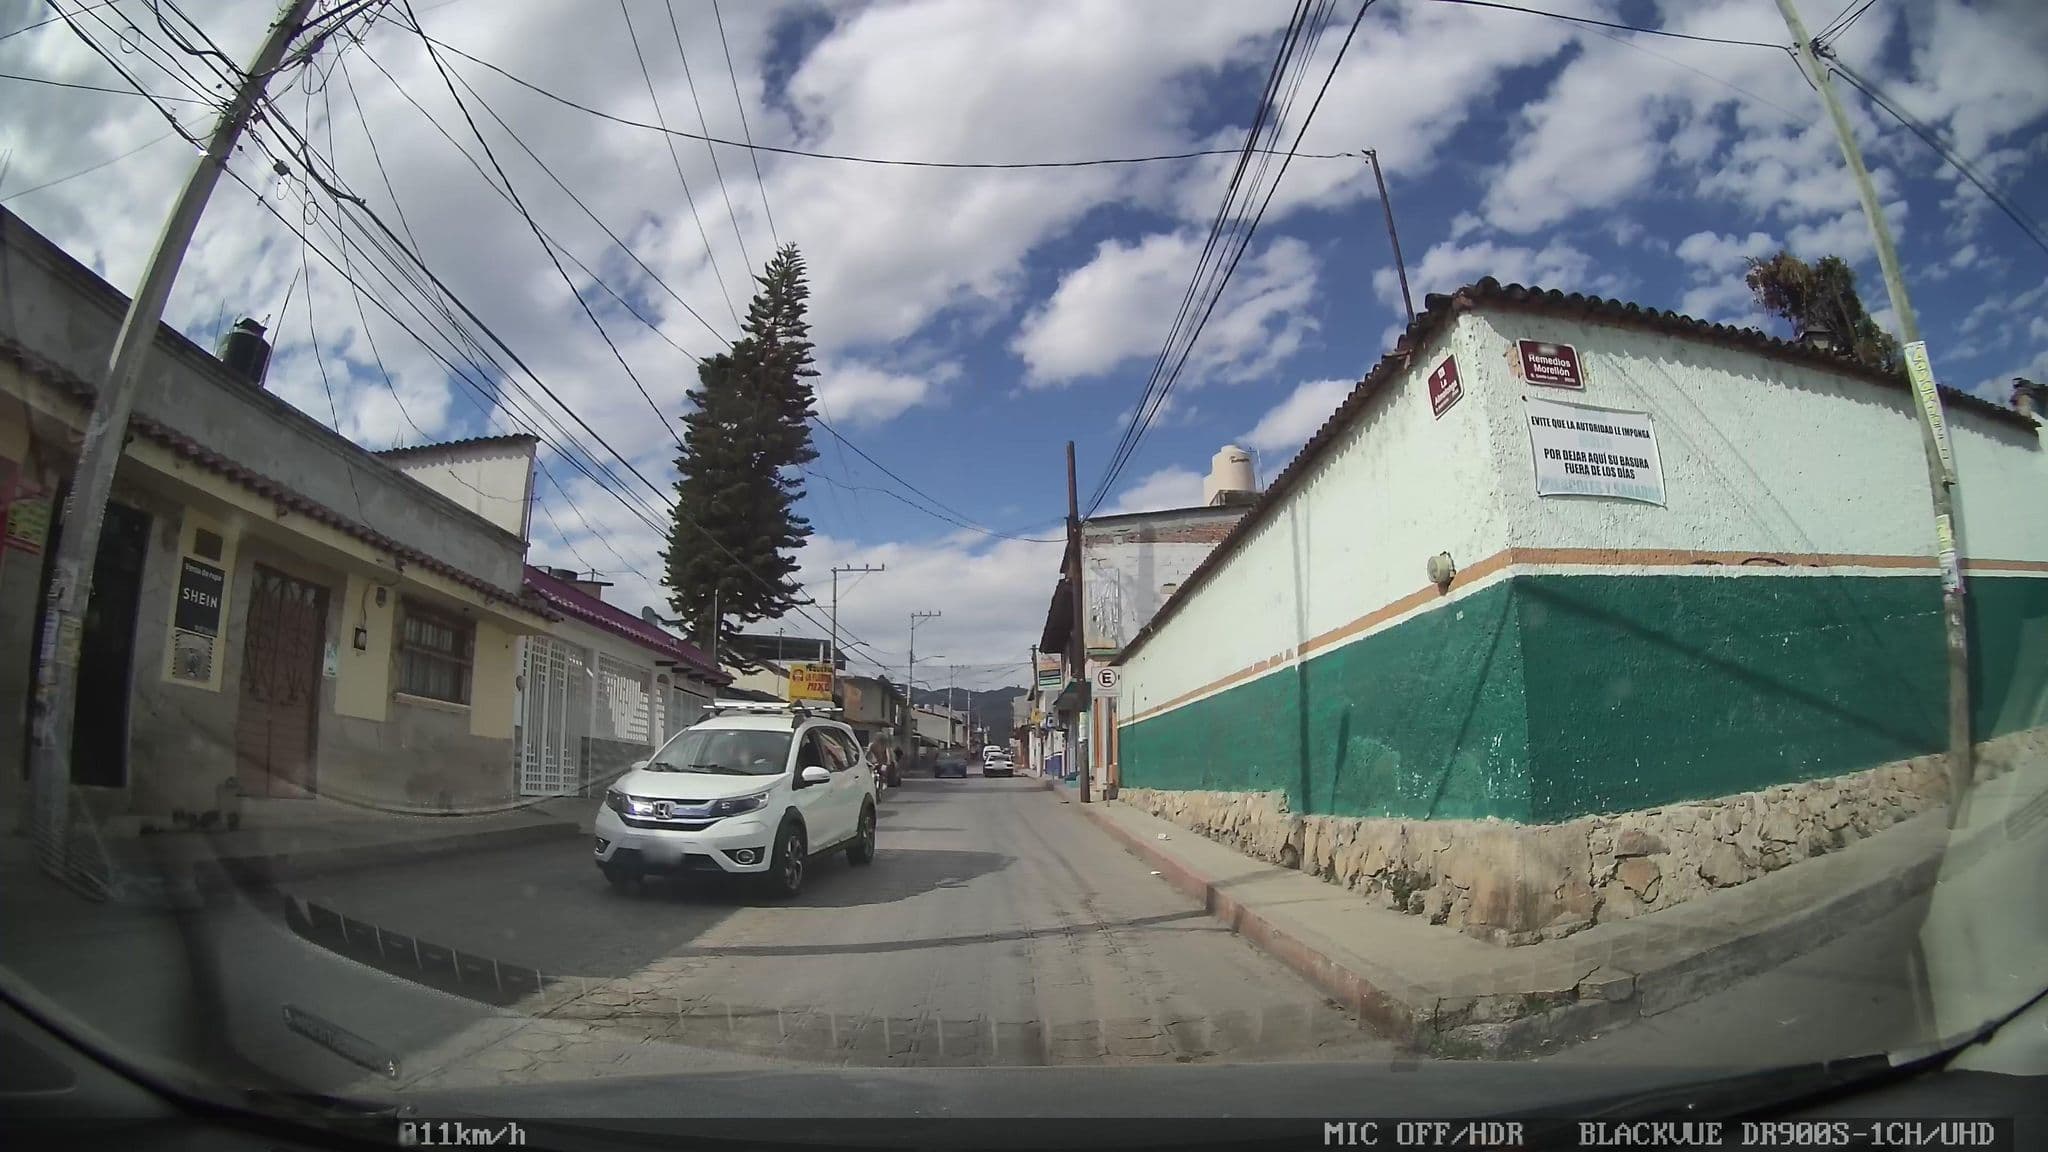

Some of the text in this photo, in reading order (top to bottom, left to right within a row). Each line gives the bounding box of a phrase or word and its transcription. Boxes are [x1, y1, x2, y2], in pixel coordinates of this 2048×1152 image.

[1528, 353, 1571, 368] Remedios
[1533, 363, 1570, 377] Morellón
[1531, 415, 1651, 440] EVITE QUE LA AUTORIDAD LE IMPONGA
[1543, 447, 1561, 460] POR
[1562, 449, 1587, 463] DEJAR
[1608, 454, 1619, 466] SU
[1619, 455, 1650, 470] BASURA
[1564, 462, 1590, 476] FUERA
[1590, 464, 1602, 476] DE
[1602, 465, 1617, 478] LOS
[183, 587, 218, 609] SHEIN
[1102, 672, 1112, 684] E
